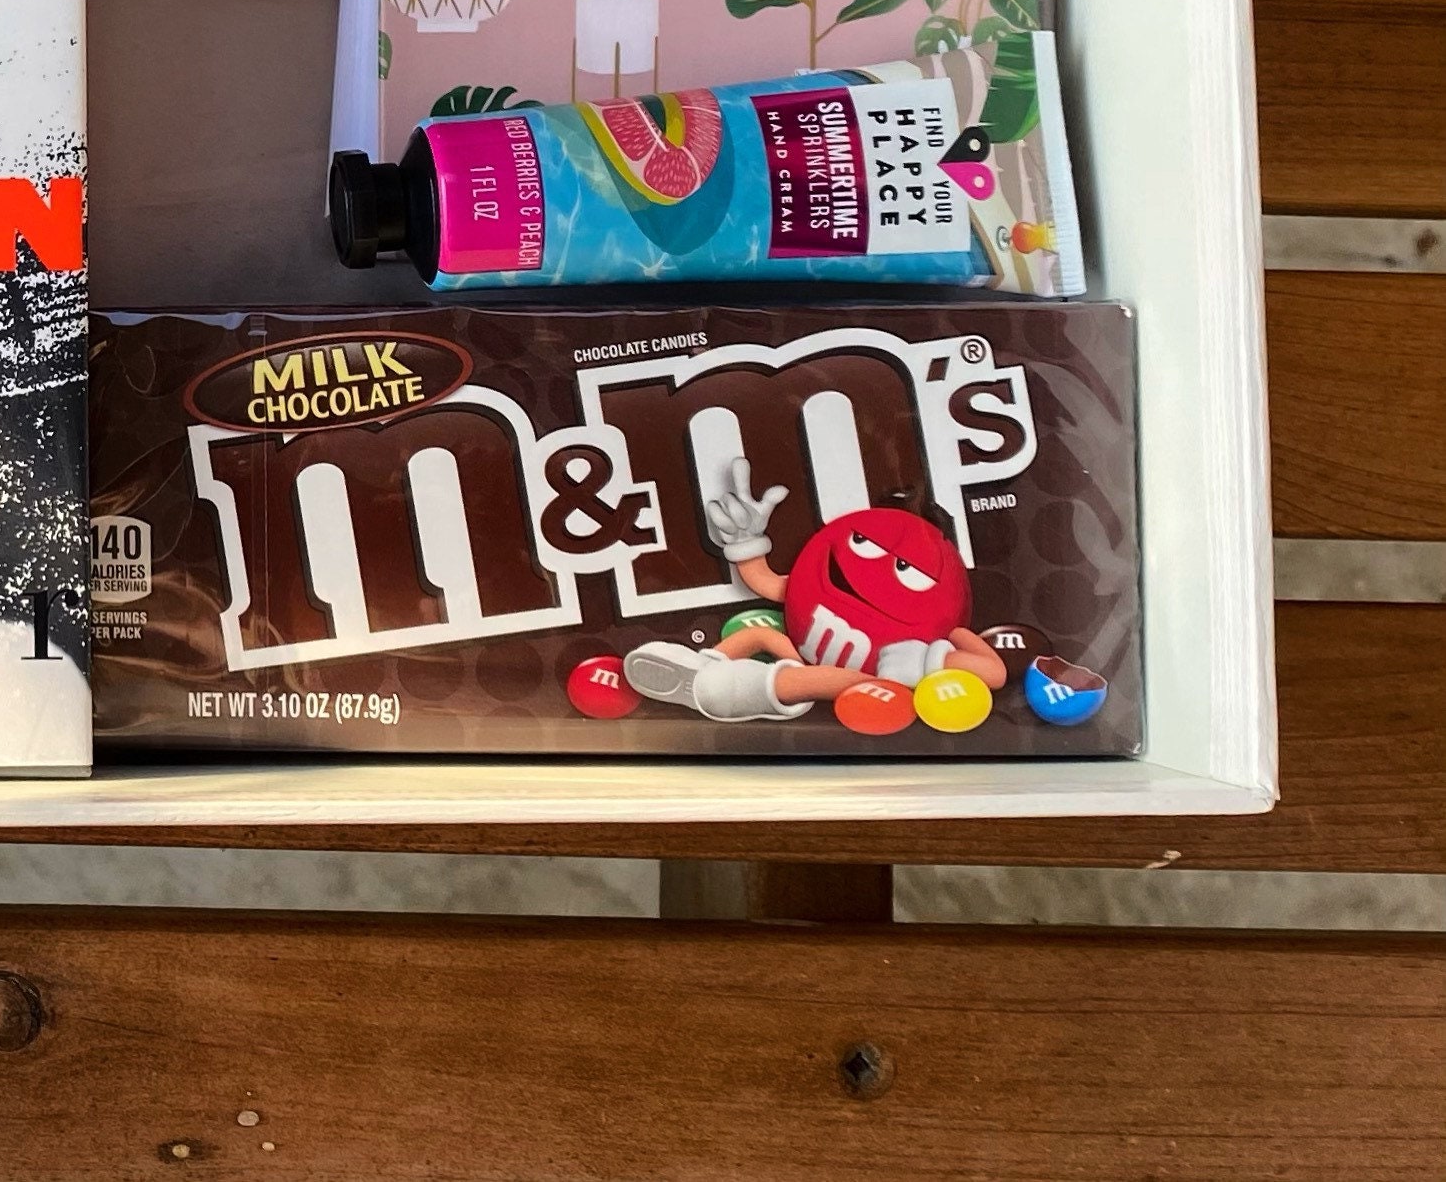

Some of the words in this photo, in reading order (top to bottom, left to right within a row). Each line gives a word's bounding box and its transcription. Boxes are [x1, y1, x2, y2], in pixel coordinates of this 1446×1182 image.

[504, 119, 529, 139] RED
[923, 107, 944, 148] FIND
[470, 165, 495, 173] 1
[511, 142, 540, 201] BERRIES
[766, 111, 788, 159] HAND
[778, 169, 793, 233] CREAM
[797, 112, 830, 229] SPRINKLERS
[817, 101, 859, 239] SUMMERTIME
[867, 110, 900, 226] PLACE
[895, 108, 926, 226] HAPPY
[471, 177, 497, 198] FL
[932, 180, 953, 224] YOUR
[473, 201, 499, 221] OZ
[519, 206, 541, 217] &
[518, 222, 541, 266] PEACH
[573, 340, 648, 363] CHOCOLATE
[651, 331, 709, 353] CANDIES
[253, 341, 413, 394] MILK
[247, 375, 425, 424] CHOCOLATE
[970, 494, 1017, 514] BRAND
[91, 524, 142, 560] 140
[91, 564, 145, 580] ALORIES
[104, 580, 148, 592] SERVING
[92, 611, 148, 625] SERVINGS
[114, 626, 142, 639] PACK
[797, 604, 872, 669] m
[995, 632, 1027, 650] m
[588, 667, 620, 690] m
[856, 682, 897, 703] m
[935, 681, 968, 702] m
[187, 691, 224, 718] NET
[227, 692, 257, 718] WT
[261, 692, 301, 718] 3.10
[305, 692, 330, 718] OZ
[334, 693, 401, 725] (87.9g)
